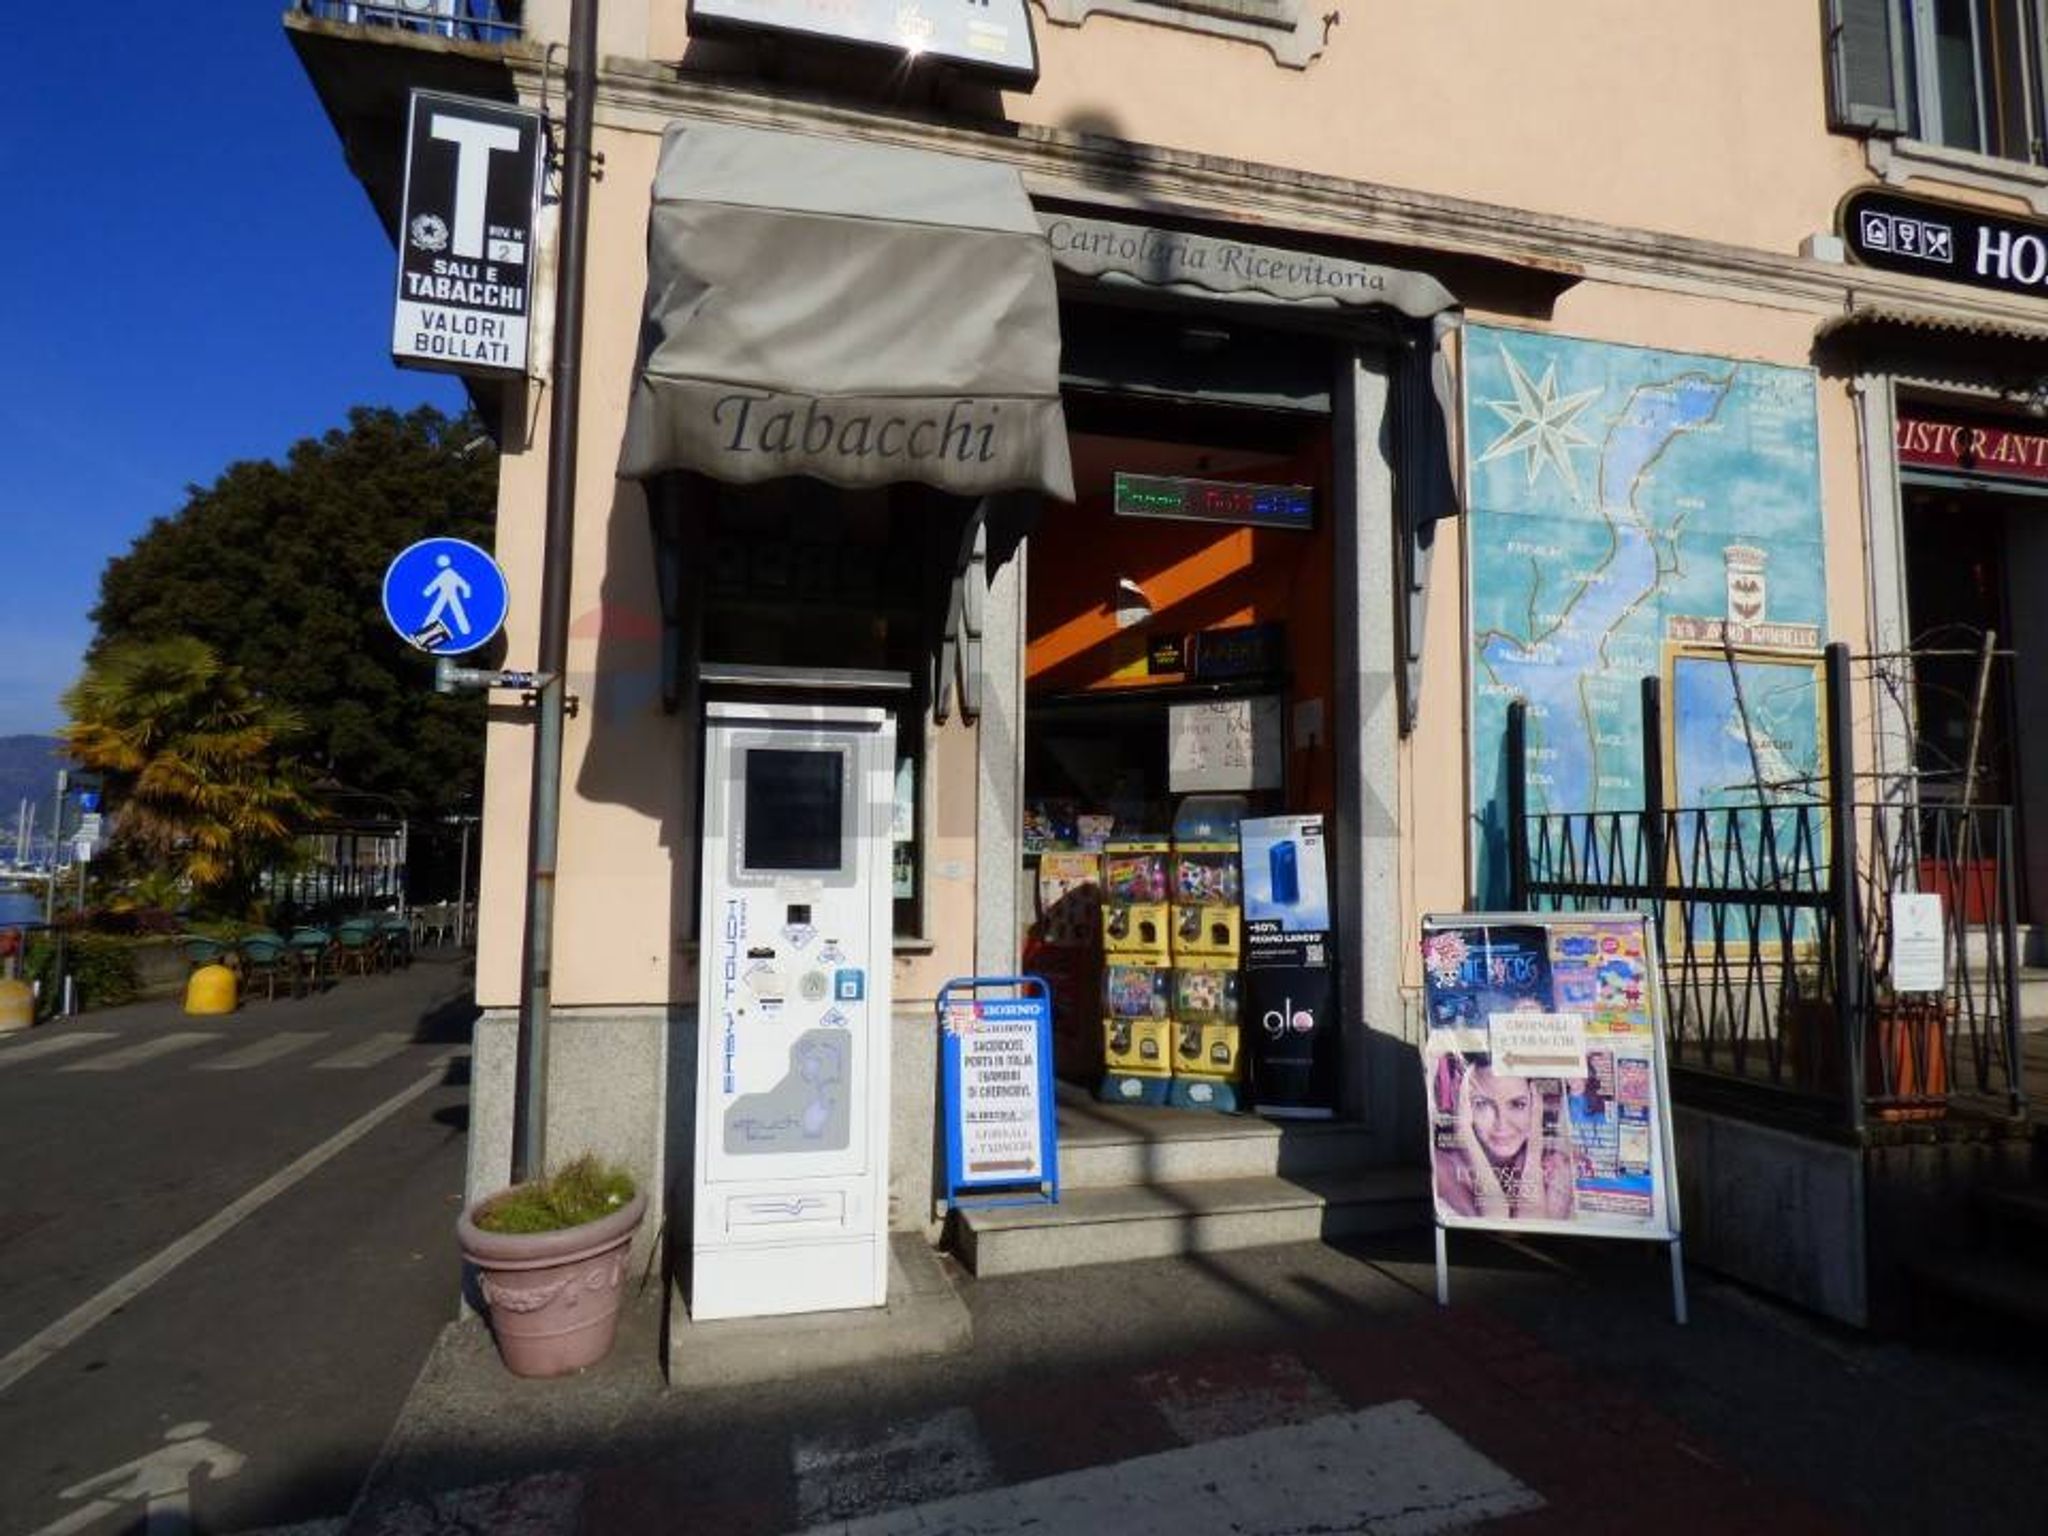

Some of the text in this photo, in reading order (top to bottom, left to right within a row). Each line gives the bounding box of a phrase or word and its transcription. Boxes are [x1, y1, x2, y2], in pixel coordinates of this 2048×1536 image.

[431, 114, 520, 259] T
[433, 259, 498, 283] SALI E
[498, 244, 510, 260] 2
[1048, 220, 1386, 292] Cartoleria Ricevitoria
[1976, 226, 2048, 285] HO
[407, 272, 523, 310] TABACCHI
[420, 309, 506, 339] VALORI
[415, 333, 510, 363] BOLLATI
[713, 393, 999, 462] Tabacchi
[1897, 420, 2048, 467] ISTORANT
[1262, 998, 1313, 1040] glo
